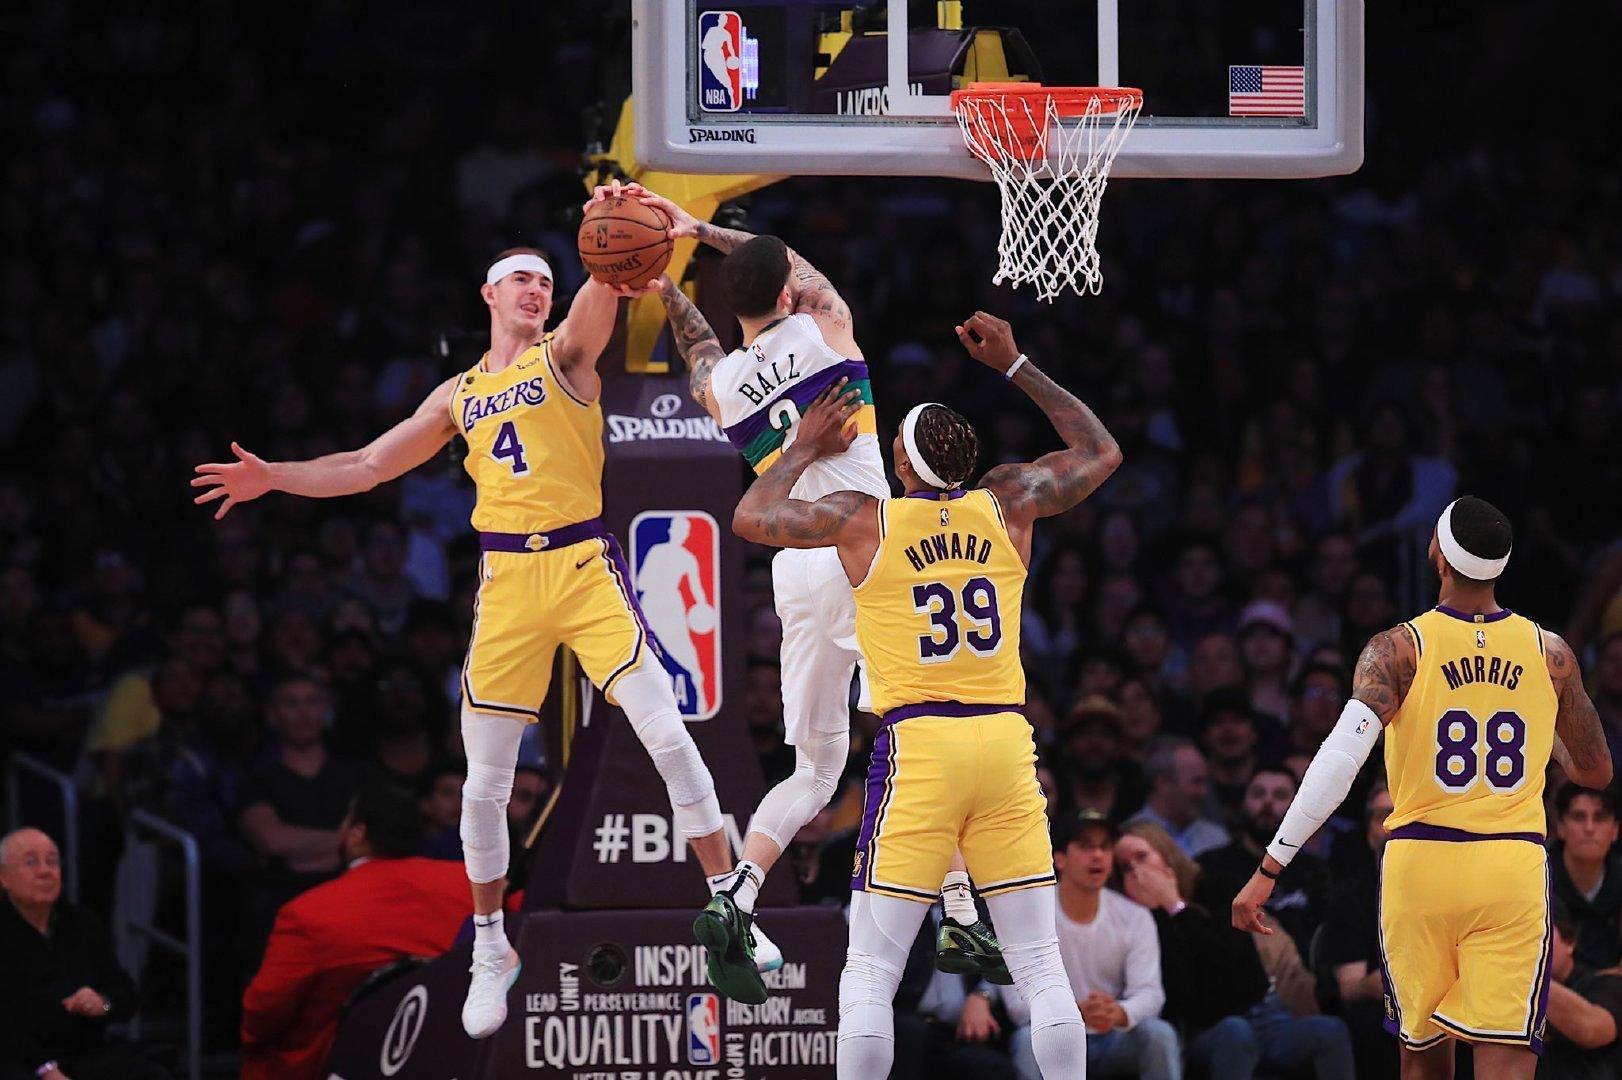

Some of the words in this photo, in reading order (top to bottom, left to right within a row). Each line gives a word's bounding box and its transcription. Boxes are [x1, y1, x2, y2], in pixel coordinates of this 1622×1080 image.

[705, 89, 726, 104] NBA
[689, 128, 757, 144] SPALDING
[738, 353, 800, 406] BALL
[463, 376, 546, 433] LAKERS
[491, 419, 531, 480] 4
[904, 532, 992, 573] HOWARD
[911, 575, 1002, 665] 39
[1440, 655, 1524, 691] MORRIS
[1434, 708, 1527, 794] 88
[525, 993, 558, 1013] LEAD
[559, 961, 580, 1012] UNIFY
[583, 992, 682, 1012] PERSEVERANCE
[726, 995, 791, 1026] HISTORY
[525, 1014, 683, 1070] EQUALITY
[725, 1033, 745, 1080] EMPO
[750, 1031, 838, 1066] ACTIVAT
